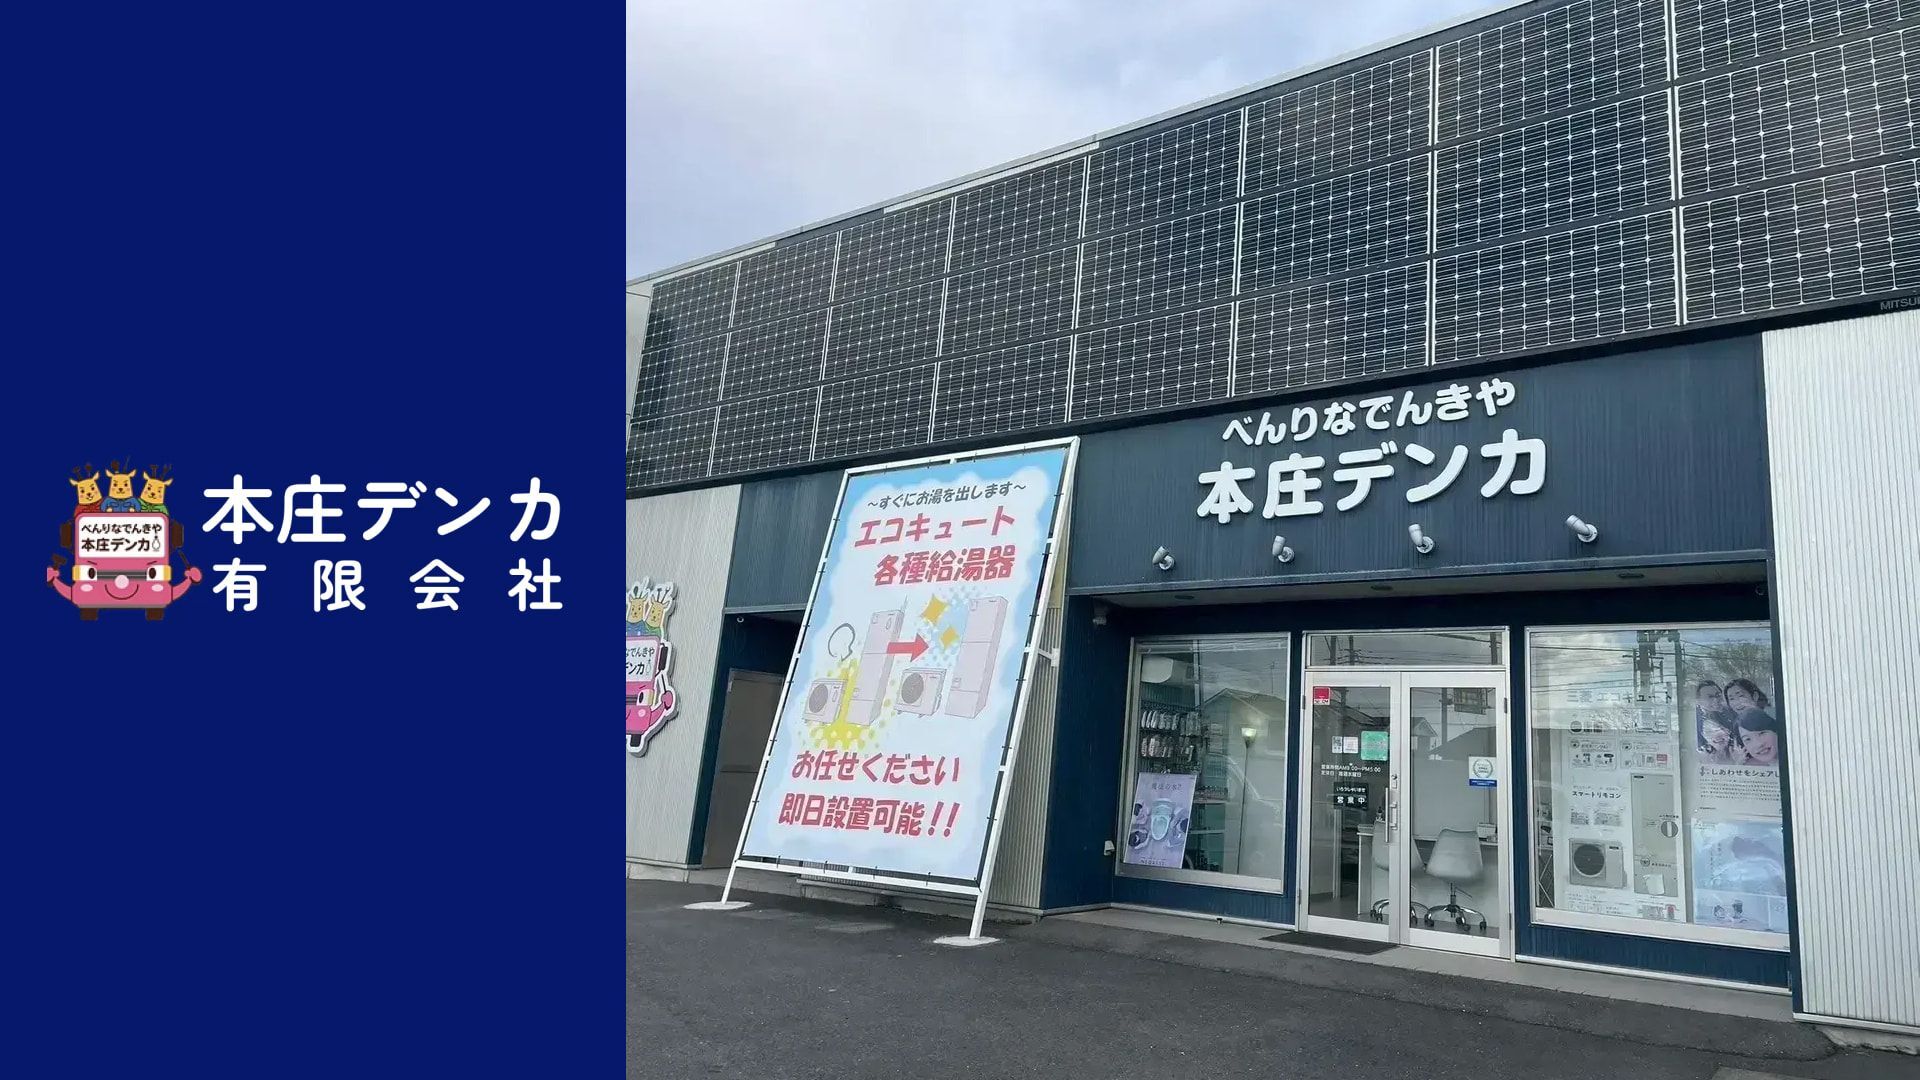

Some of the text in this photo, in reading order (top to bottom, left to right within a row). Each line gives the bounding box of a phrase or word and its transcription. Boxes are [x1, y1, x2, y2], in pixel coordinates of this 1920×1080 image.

[1881, 297, 1920, 310] MITSU
[1222, 377, 1517, 447] べんりなでんきや
[1196, 428, 1548, 525] 本庄デンカ
[854, 505, 1017, 549] エコキュート
[873, 543, 1018, 586] 各種給湯器
[791, 749, 961, 787] お任せください
[1572, 790, 1623, 800] スマートリモコン
